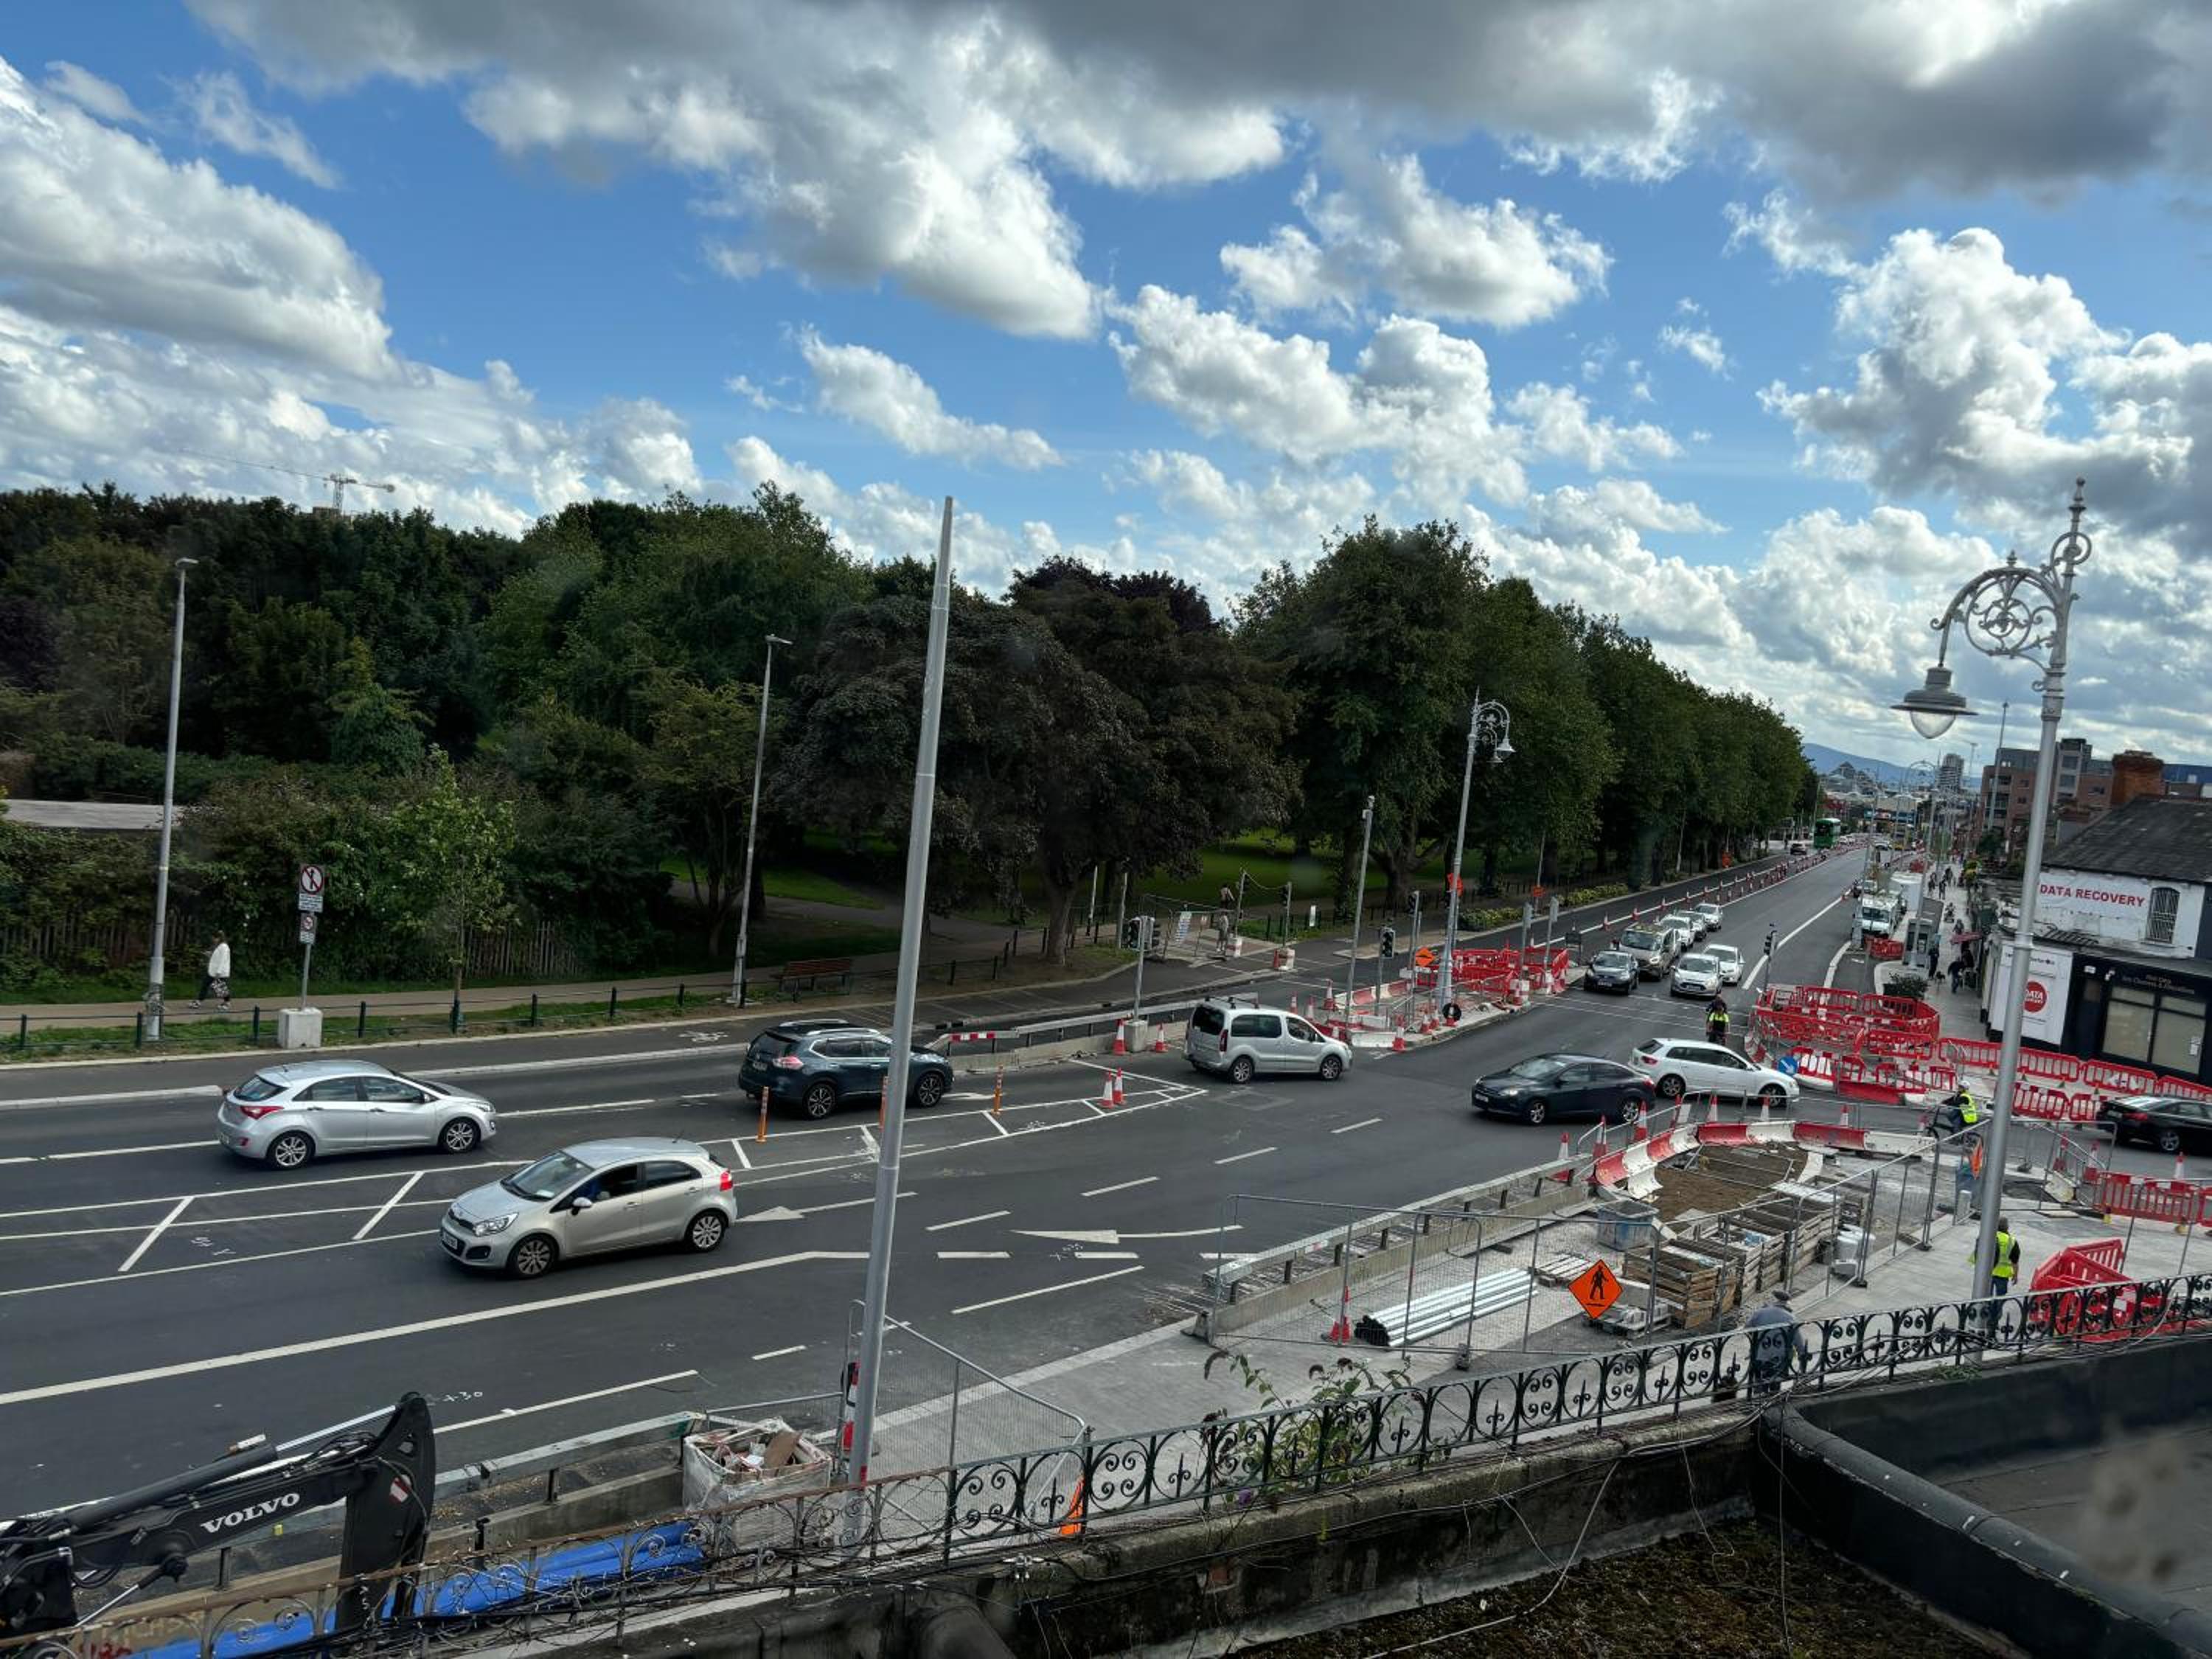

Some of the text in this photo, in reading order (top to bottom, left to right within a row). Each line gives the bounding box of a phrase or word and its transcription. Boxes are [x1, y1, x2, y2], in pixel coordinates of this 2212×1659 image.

[2040, 884, 2145, 907] DATA RECOVERY
[201, 1493, 300, 1533] VOLVO
